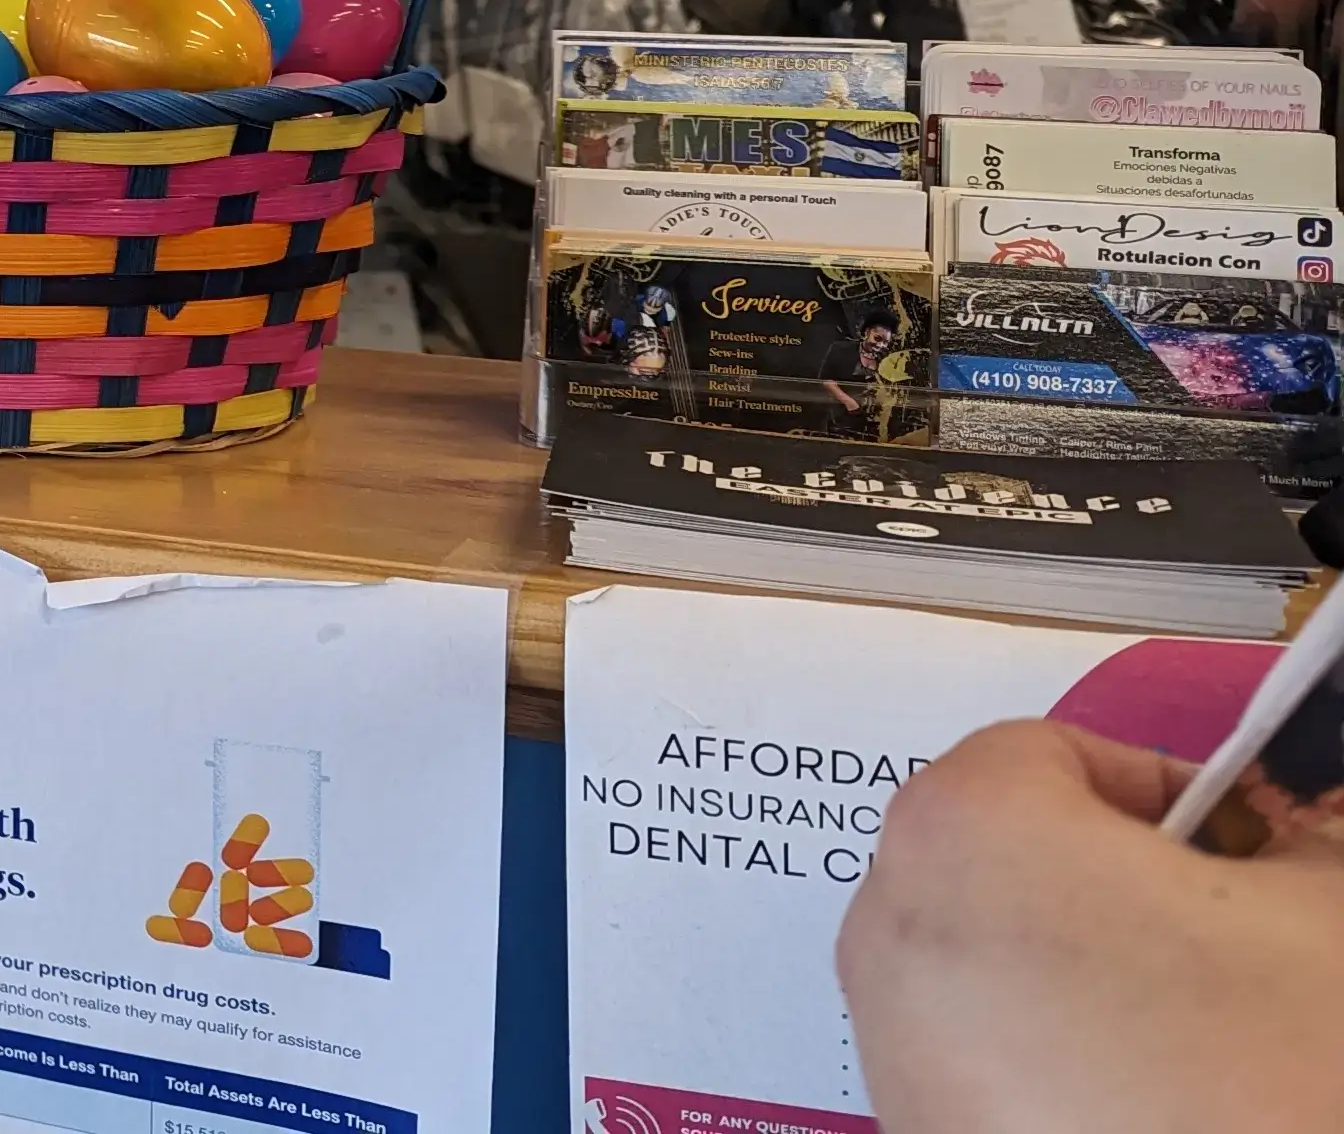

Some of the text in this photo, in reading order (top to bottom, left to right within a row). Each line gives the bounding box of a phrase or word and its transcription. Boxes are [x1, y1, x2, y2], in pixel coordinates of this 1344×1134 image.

[633, 52, 850, 73] MINISTERIO PENTECOSTES
[693, 73, 749, 89] ISAIAS
[1190, 79, 1210, 93] OF
[1215, 81, 1256, 96] YOUR
[1259, 82, 1302, 97] NAILS
[667, 116, 811, 167] MES
[1128, 144, 1222, 162] Transforma
[1113, 160, 1237, 177] Emociones Negativas
[1146, 173, 1204, 187] debidas a
[622, 186, 838, 207] Quality cleaning with a personal Touch
[1095, 183, 1255, 202] Situaciones desafortunadas
[719, 207, 774, 240] TOUC
[1097, 247, 1262, 271] Rotulacion Con
[701, 277, 823, 323] Services
[709, 329, 803, 347] Protective styles
[708, 346, 755, 360] Sew-ins
[708, 362, 759, 379] Braiding
[1012, 362, 1063, 374] CALL TODAY
[708, 380, 752, 394] Retwist
[971, 370, 1119, 396] (410) 908-7337
[708, 396, 803, 414] Hair Treatments
[728, 480, 1079, 522] EASTER AT EPIC
[581, 774, 883, 836] NO INSURANC
[607, 821, 809, 881] DENTAL
[38, 962, 158, 999] prescription
[162, 982, 210, 1008] drug
[214, 994, 278, 1017] costs.
[0, 979, 29, 999] and
[31, 985, 70, 1007] don't
[73, 995, 122, 1016] realize
[124, 1003, 157, 1025] they
[161, 1011, 193, 1034] may
[196, 1017, 250, 1044] qualify
[252, 1026, 275, 1043] for
[277, 1031, 363, 1062] assistance
[41, 1050, 57, 1068] Is
[59, 1054, 97, 1077] Less
[99, 1062, 140, 1086] Than
[164, 1075, 388, 1134] Total Assets Are Less Than
